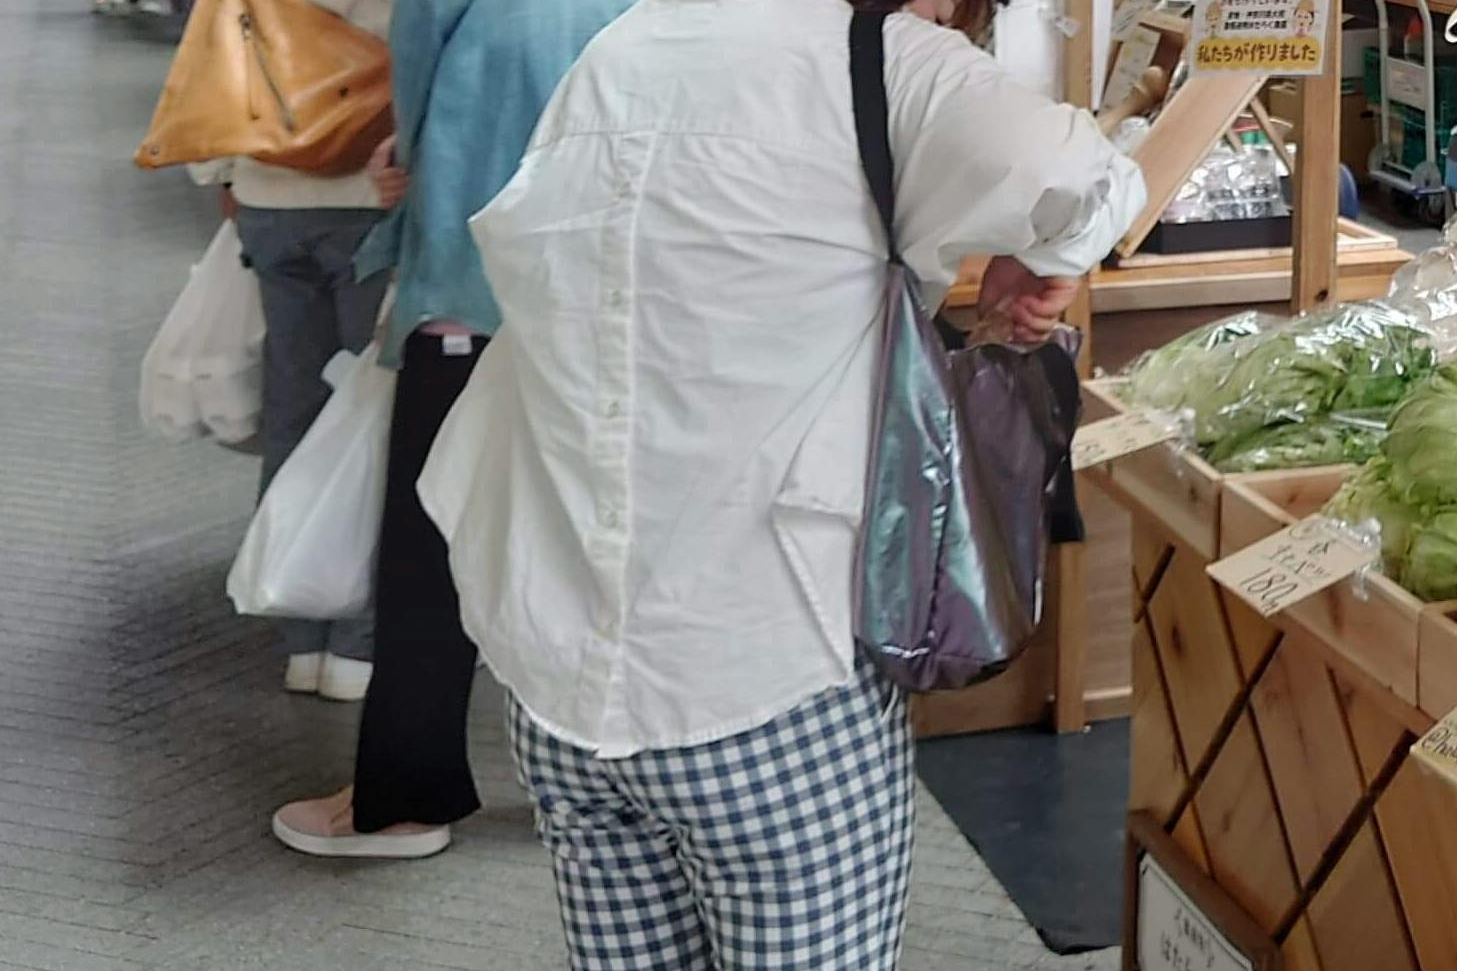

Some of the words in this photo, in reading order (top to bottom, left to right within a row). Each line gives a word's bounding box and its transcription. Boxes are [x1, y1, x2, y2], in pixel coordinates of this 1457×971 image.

[1197, 43, 1316, 62] 私たちが作りました
